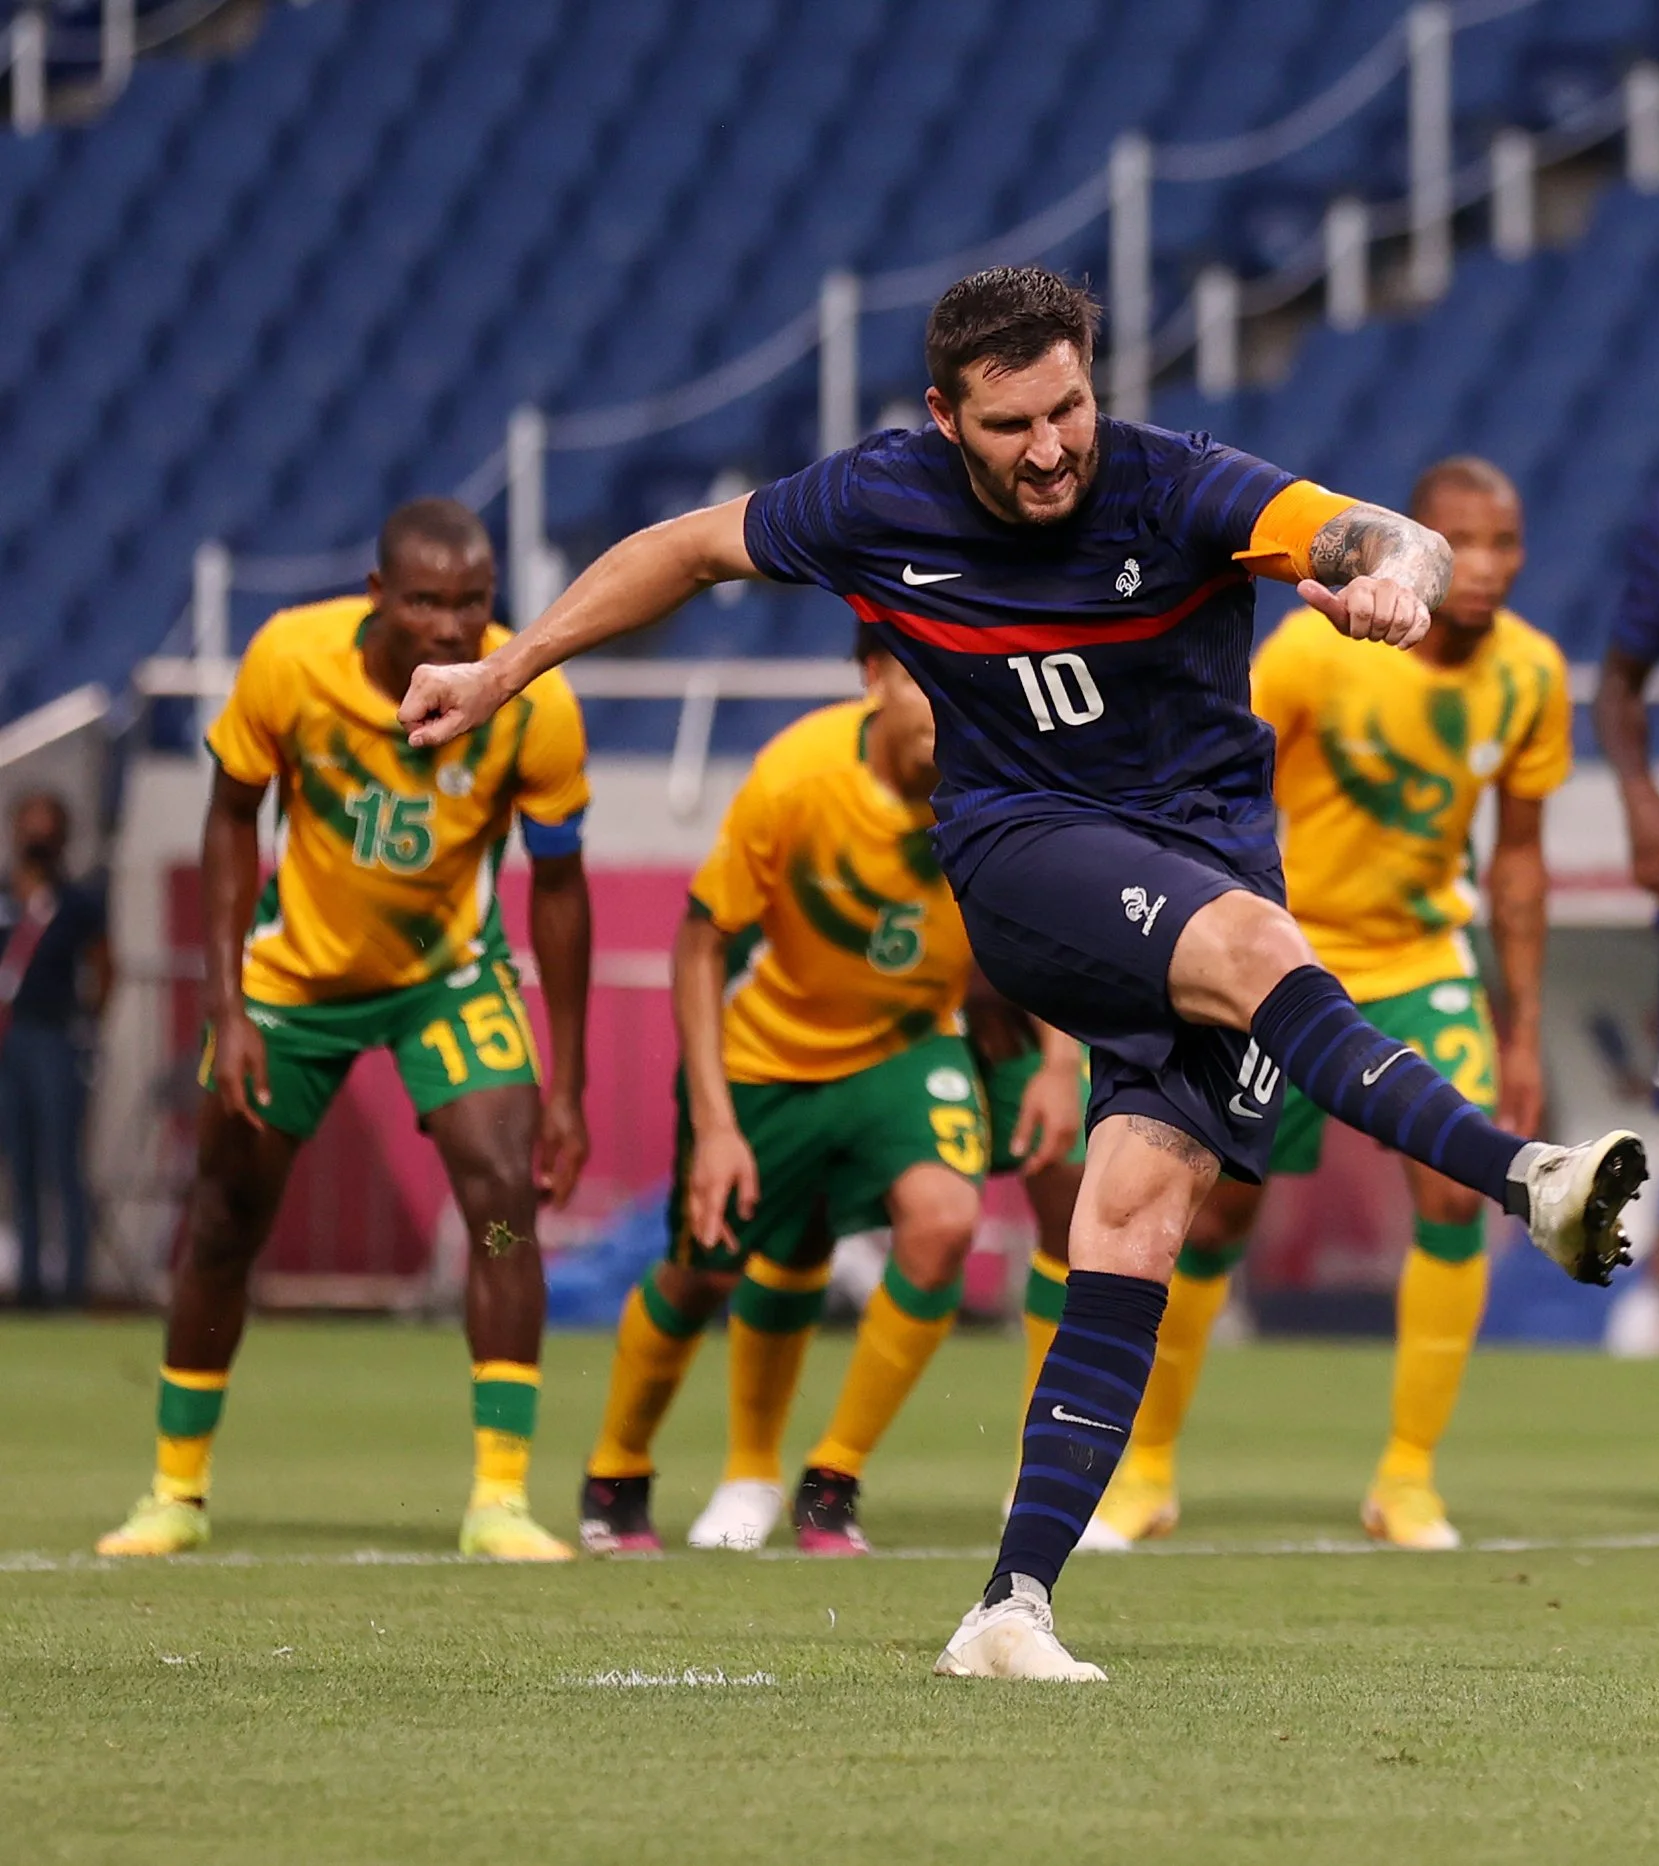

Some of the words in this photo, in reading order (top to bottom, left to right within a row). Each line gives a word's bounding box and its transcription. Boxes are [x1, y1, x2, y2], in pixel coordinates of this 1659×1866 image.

[1007, 653, 1105, 732] 10
[345, 783, 437, 875] 15
[866, 900, 926, 976] 5
[421, 993, 527, 1085] 15
[928, 1105, 984, 1175] 5
